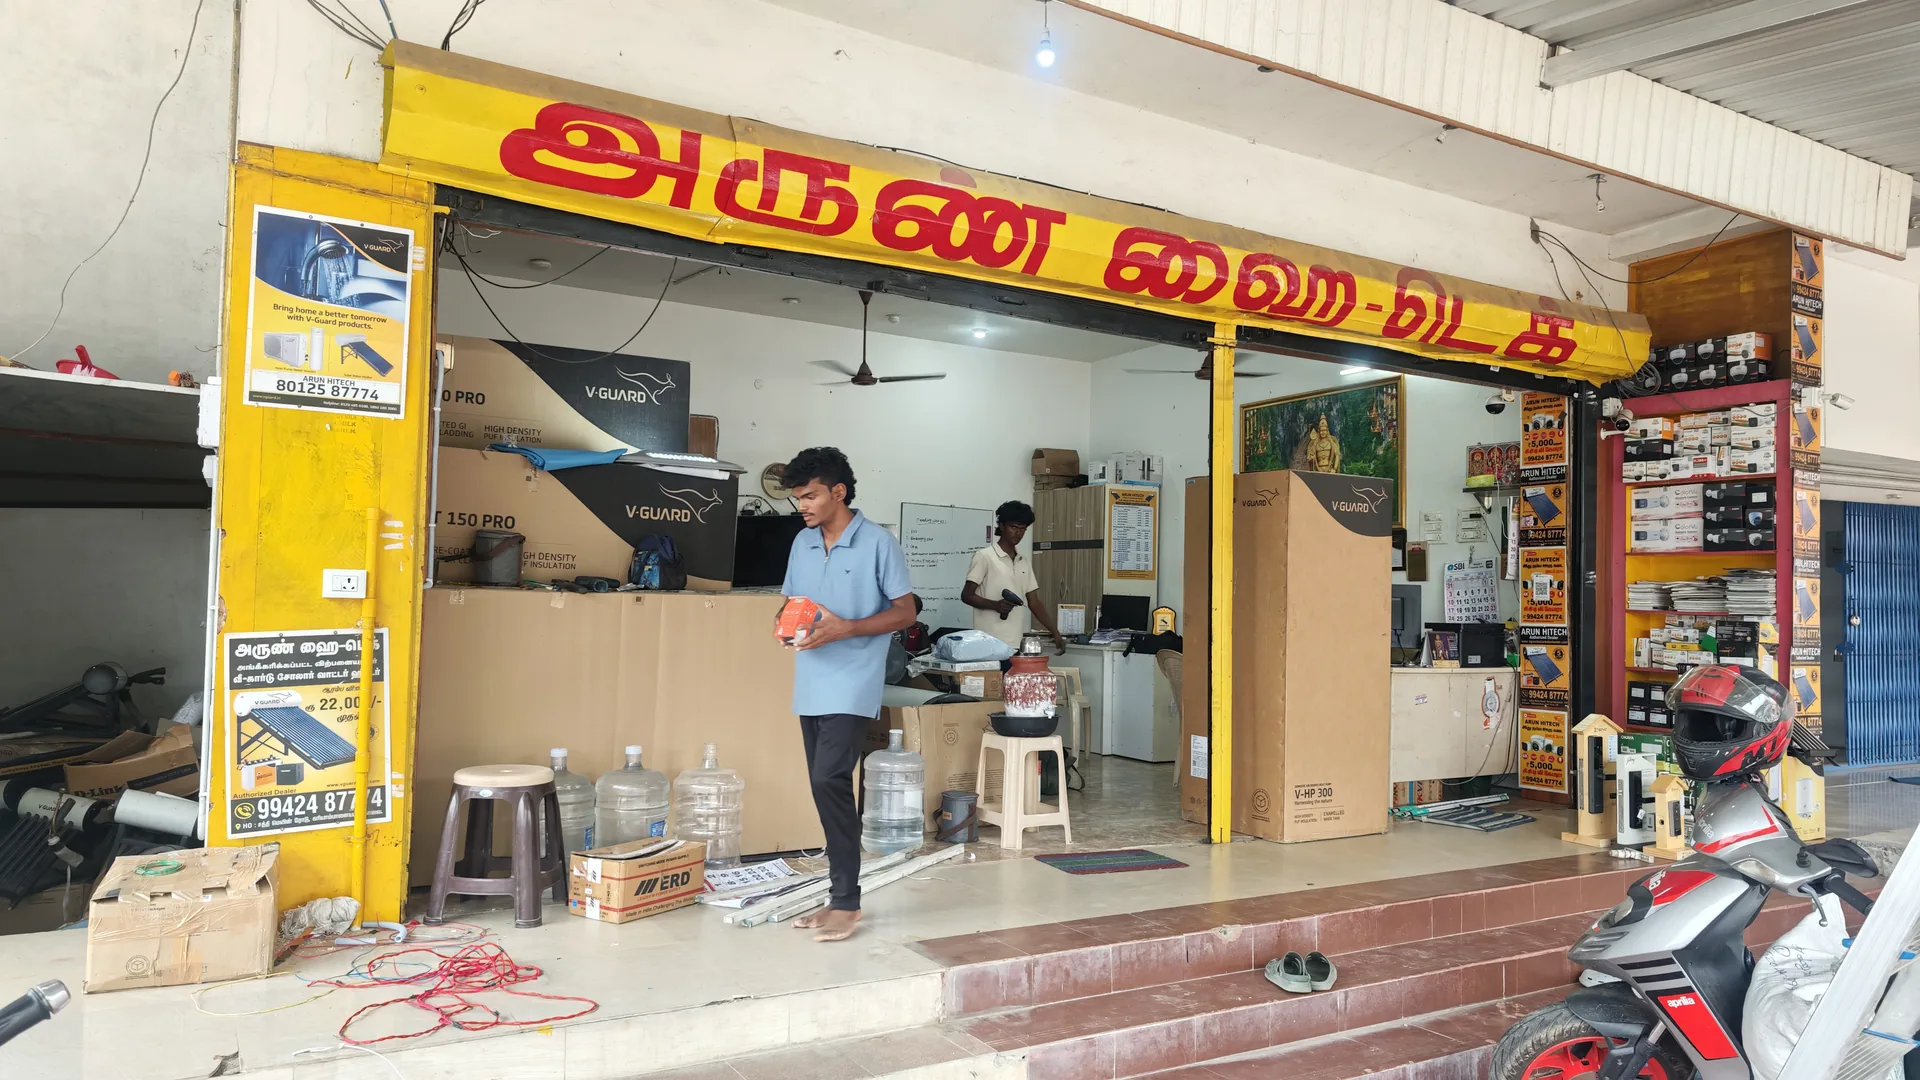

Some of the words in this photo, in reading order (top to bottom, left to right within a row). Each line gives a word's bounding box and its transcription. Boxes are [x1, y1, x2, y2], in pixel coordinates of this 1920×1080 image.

[499, 101, 1067, 275] அருண்
[1792, 294, 1805, 304] ARUN
[1805, 298, 1822, 309] HITECH
[273, 304, 294, 314] Bring
[295, 305, 317, 315] home
[325, 310, 349, 319] better
[350, 313, 387, 323] tomorrow
[306, 316, 336, 325] V-Guard
[338, 320, 373, 330] products.
[303, 376, 325, 384] ARUN
[327, 378, 355, 387] HITECH
[276, 379, 325, 395] 80125
[331, 385, 379, 400] 87774
[585, 385, 646, 403] V-GUARD
[455, 390, 486, 405] PRO
[484, 425, 505, 433] HIGH
[507, 426, 542, 436] DENSITY
[484, 432, 499, 440] PUF
[1521, 469, 1540, 478] ARUN
[1541, 466, 1566, 476] HITECH
[625, 504, 691, 522] V-GUARD
[1331, 501, 1369, 513] V-GUARD
[447, 512, 478, 526] 150
[482, 514, 516, 529] PRO
[1547, 530, 1566, 538] 87774
[538, 552, 577, 562] DENSITY
[530, 561, 577, 570] INSULATION
[1521, 628, 1541, 636] ARUN
[1542, 628, 1567, 636] HITECH
[235, 638, 294, 659] அருண்
[1528, 690, 1548, 699] 99424
[1549, 690, 1568, 700] 87774
[320, 696, 381, 711] 22,00/-
[1525, 776, 1544, 784] 99424
[1544, 778, 1562, 786] 87774
[233, 789, 273, 799] Authorized
[274, 788, 297, 796] Dealer
[1295, 788, 1315, 799] V-HP
[1317, 787, 1332, 798] 300
[257, 794, 318, 819] 99424
[660, 871, 690, 891] ERD
[1667, 996, 1695, 1008] aprilia
